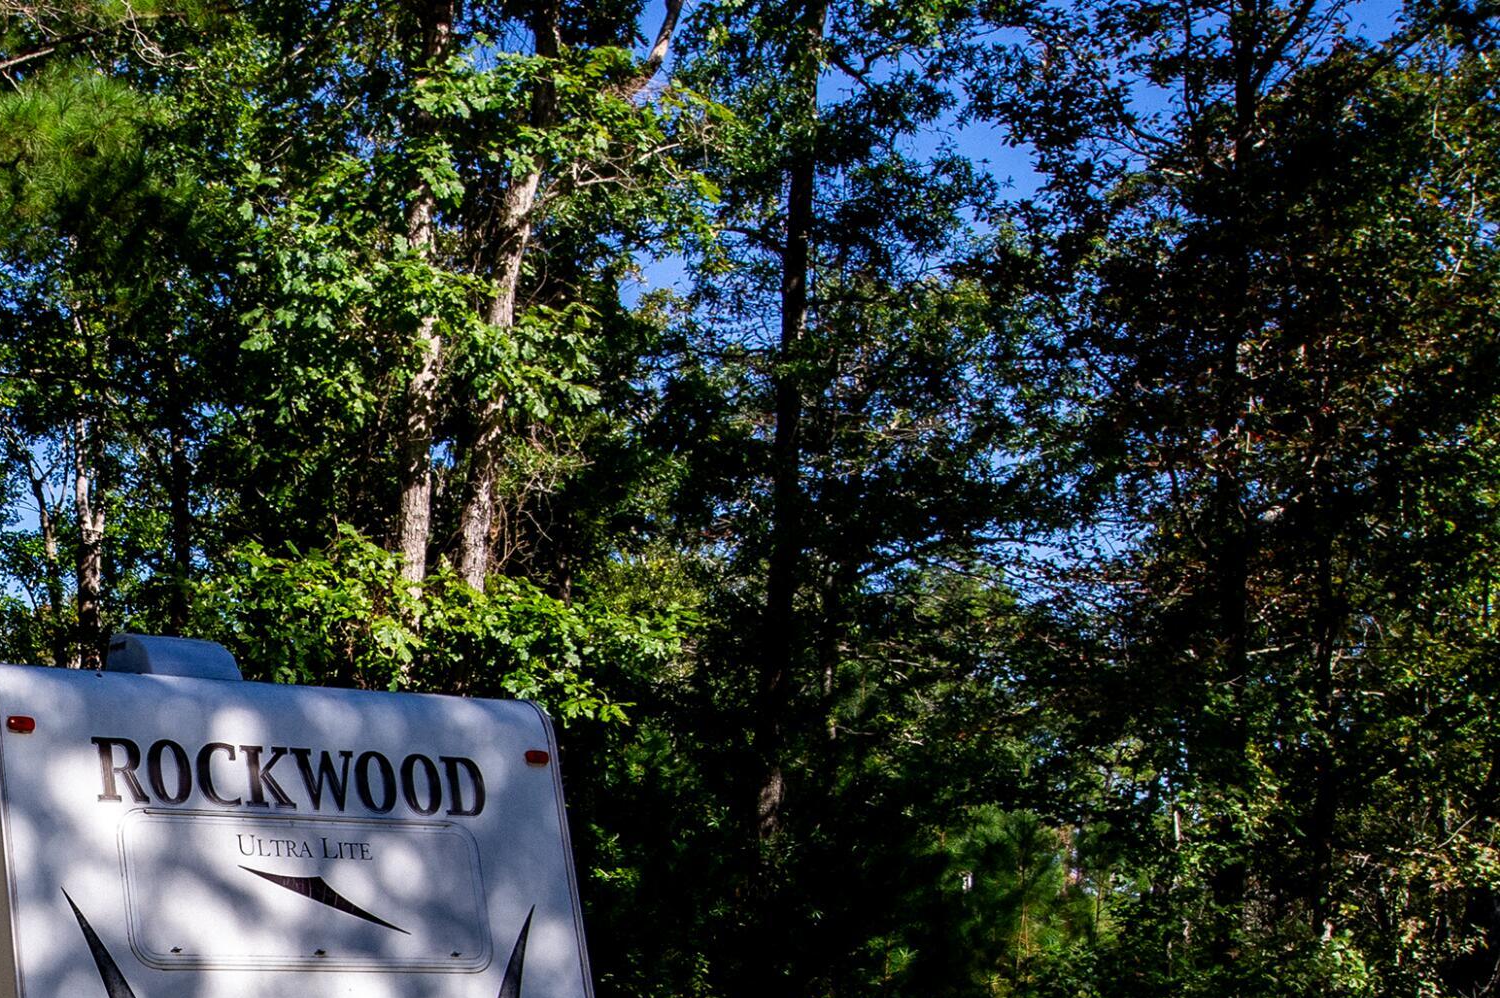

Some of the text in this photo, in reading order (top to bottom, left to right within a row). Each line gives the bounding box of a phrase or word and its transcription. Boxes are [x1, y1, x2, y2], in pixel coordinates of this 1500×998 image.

[90, 736, 486, 817] ROCKWOOD
[236, 833, 373, 861] ULTRA LITE
